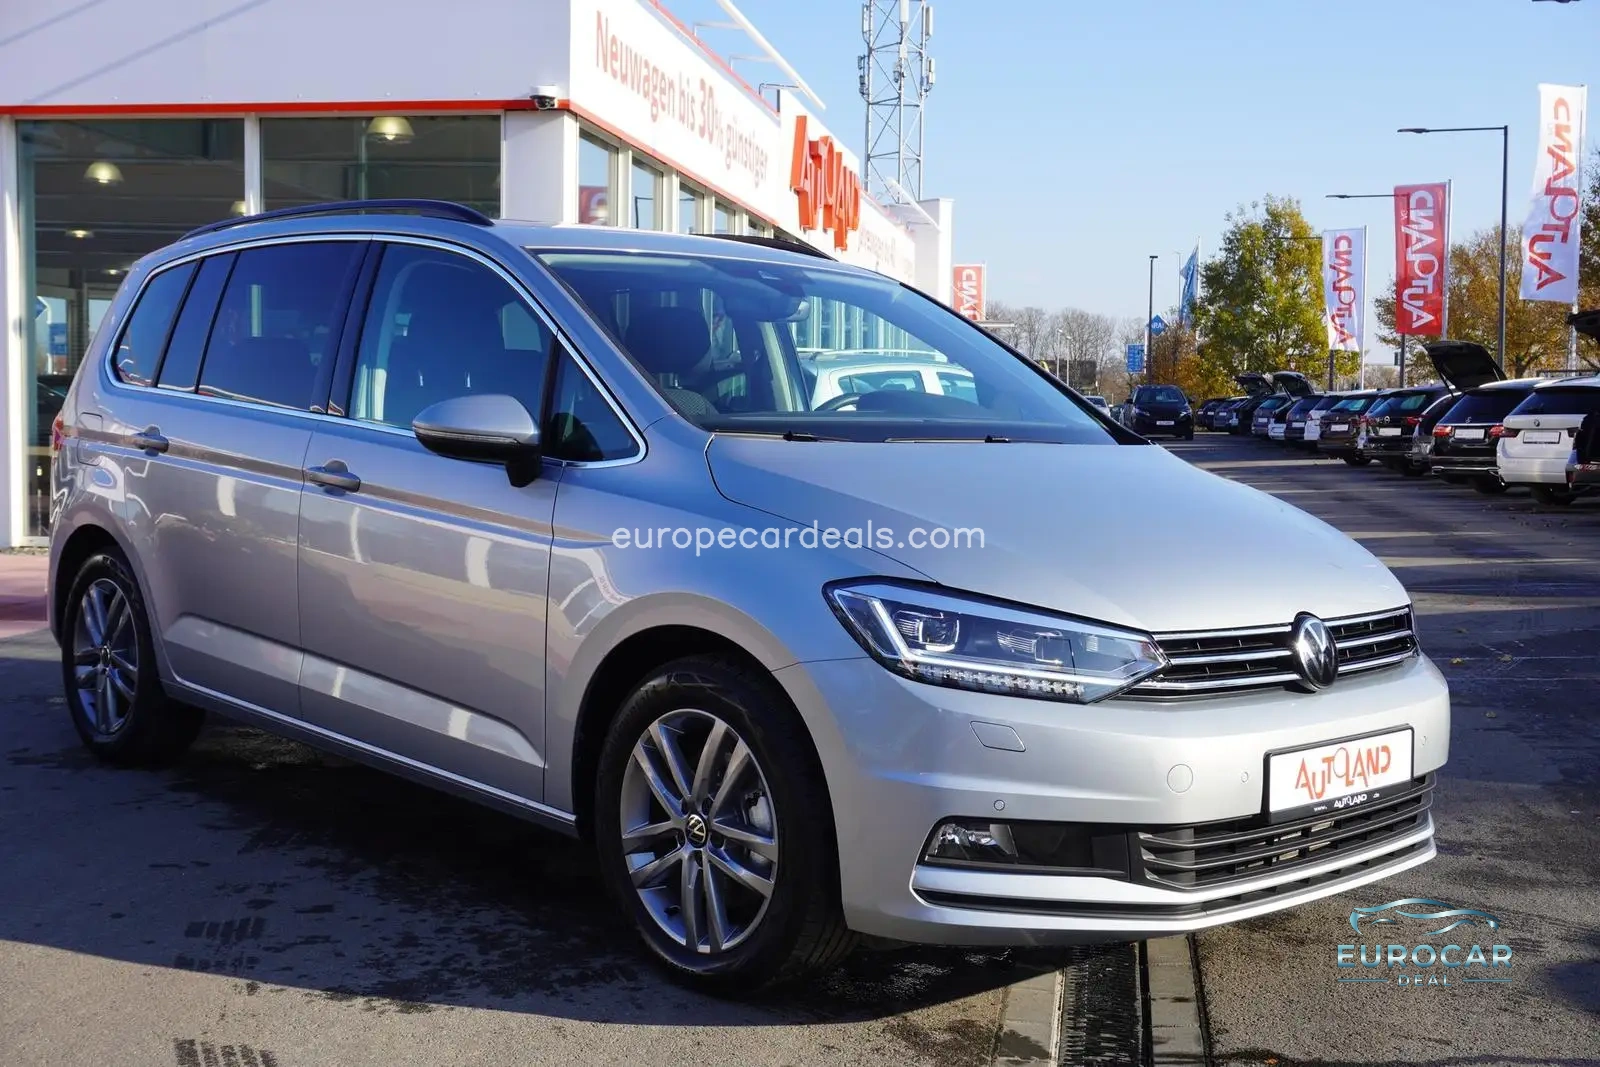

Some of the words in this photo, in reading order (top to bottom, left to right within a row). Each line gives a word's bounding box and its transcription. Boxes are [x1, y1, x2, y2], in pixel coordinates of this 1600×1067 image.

[597, 10, 675, 123] Neuwagen
[679, 71, 696, 133] bis
[699, 77, 724, 151] 30%
[725, 113, 768, 189] günstiger
[1295, 745, 1391, 800] AUTOLAND
